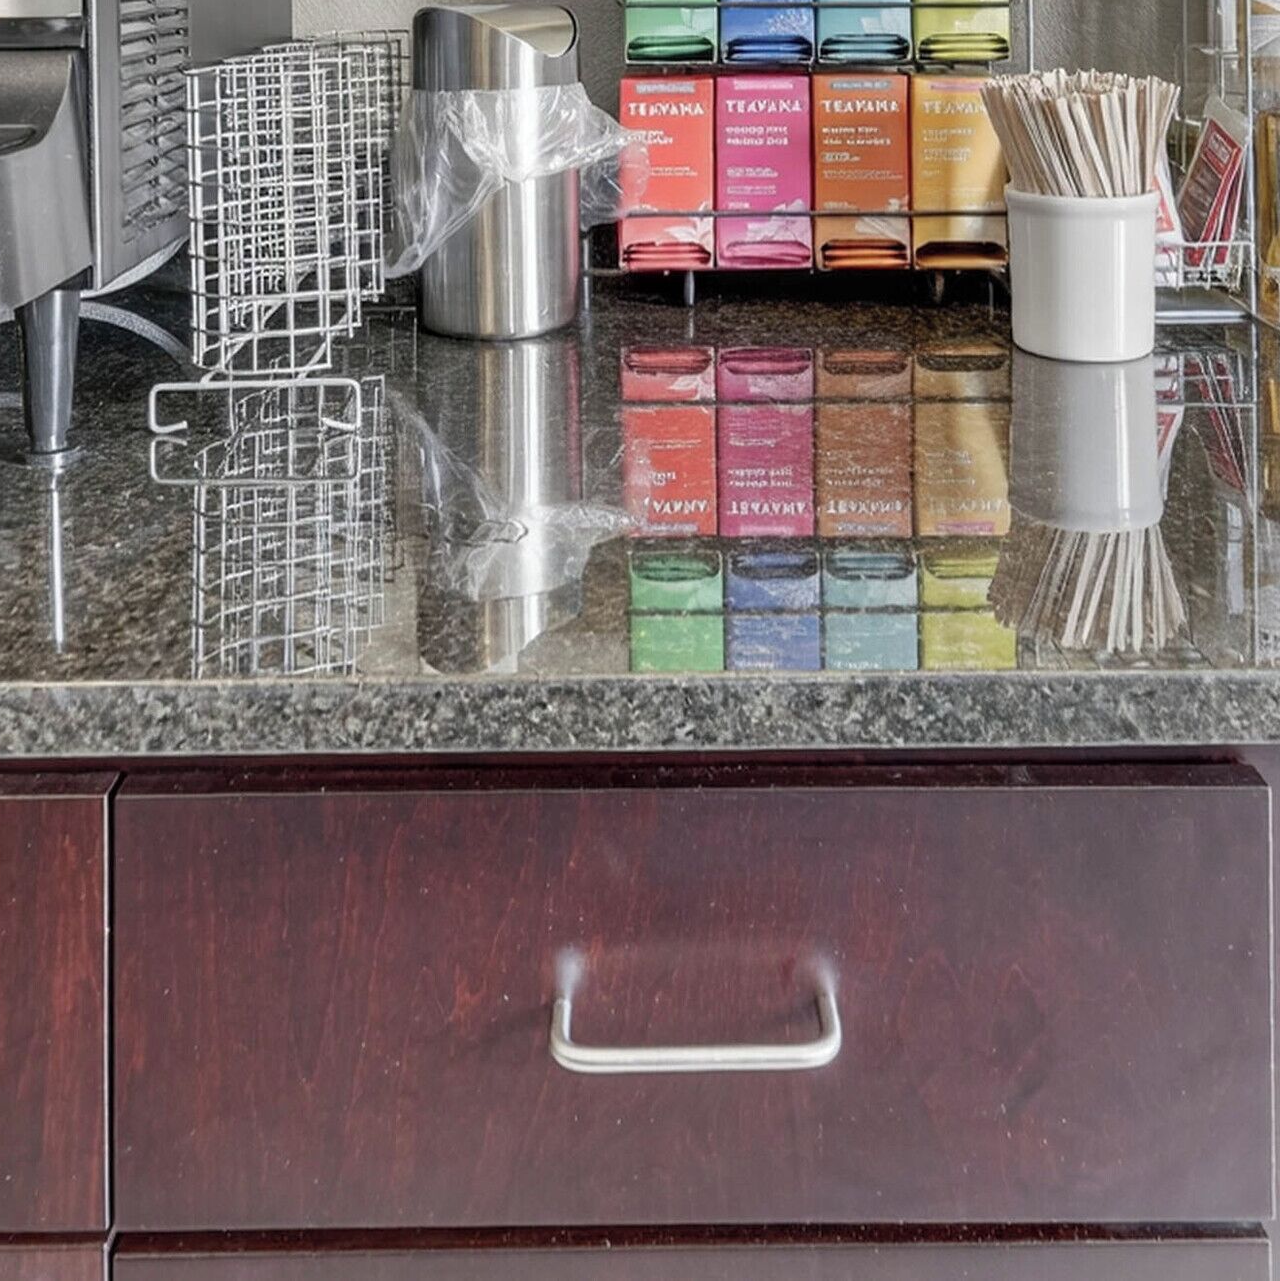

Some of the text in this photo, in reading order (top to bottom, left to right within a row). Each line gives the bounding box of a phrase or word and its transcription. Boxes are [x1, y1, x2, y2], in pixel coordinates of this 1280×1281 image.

[628, 102, 705, 117] TEAVANA
[726, 99, 803, 114] TEAVANA
[822, 99, 900, 114] TEAVANA
